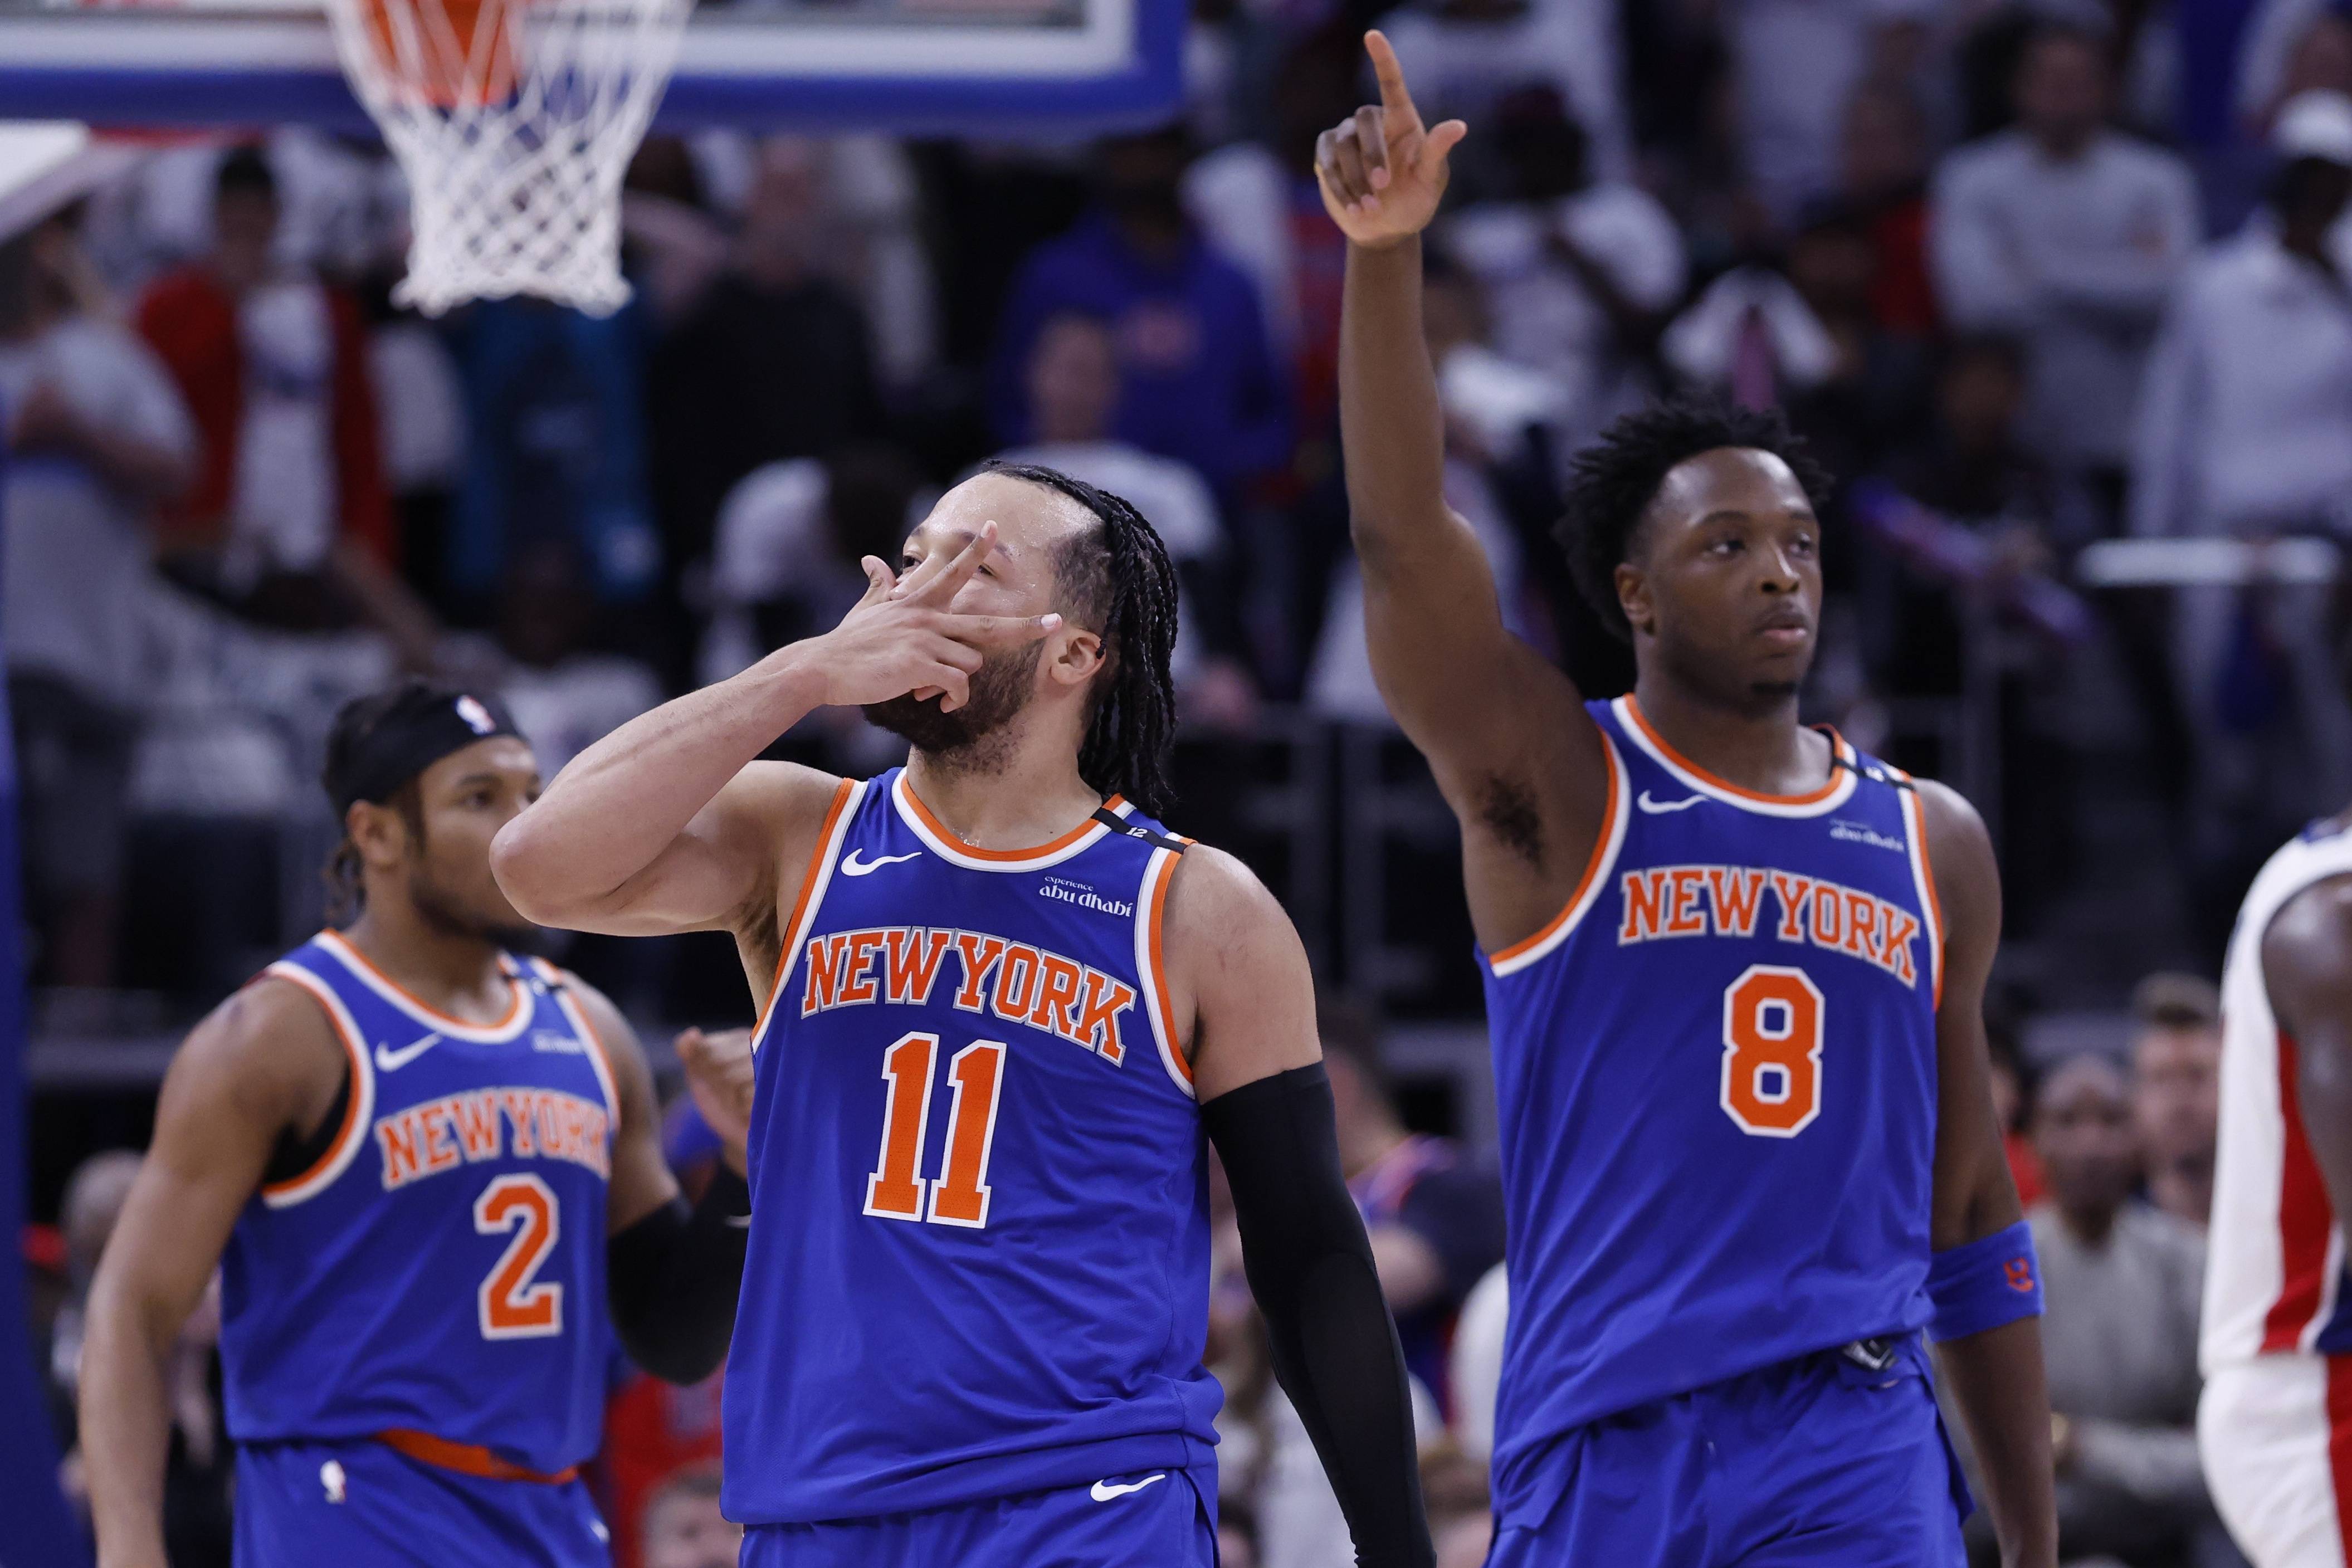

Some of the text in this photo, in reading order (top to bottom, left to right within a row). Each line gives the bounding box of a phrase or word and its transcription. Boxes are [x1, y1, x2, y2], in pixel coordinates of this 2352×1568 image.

[1044, 875, 1094, 891] experience
[1125, 827, 1148, 838] 12
[1039, 885, 1134, 917] abu dhabi
[1617, 864, 1921, 990] NEW YORK
[801, 926, 1138, 1068] NEW YORK
[1720, 964, 1825, 1138] 8
[374, 1087, 501, 1191] NEW
[862, 1031, 1007, 1229] 11
[473, 1173, 563, 1340] 2
